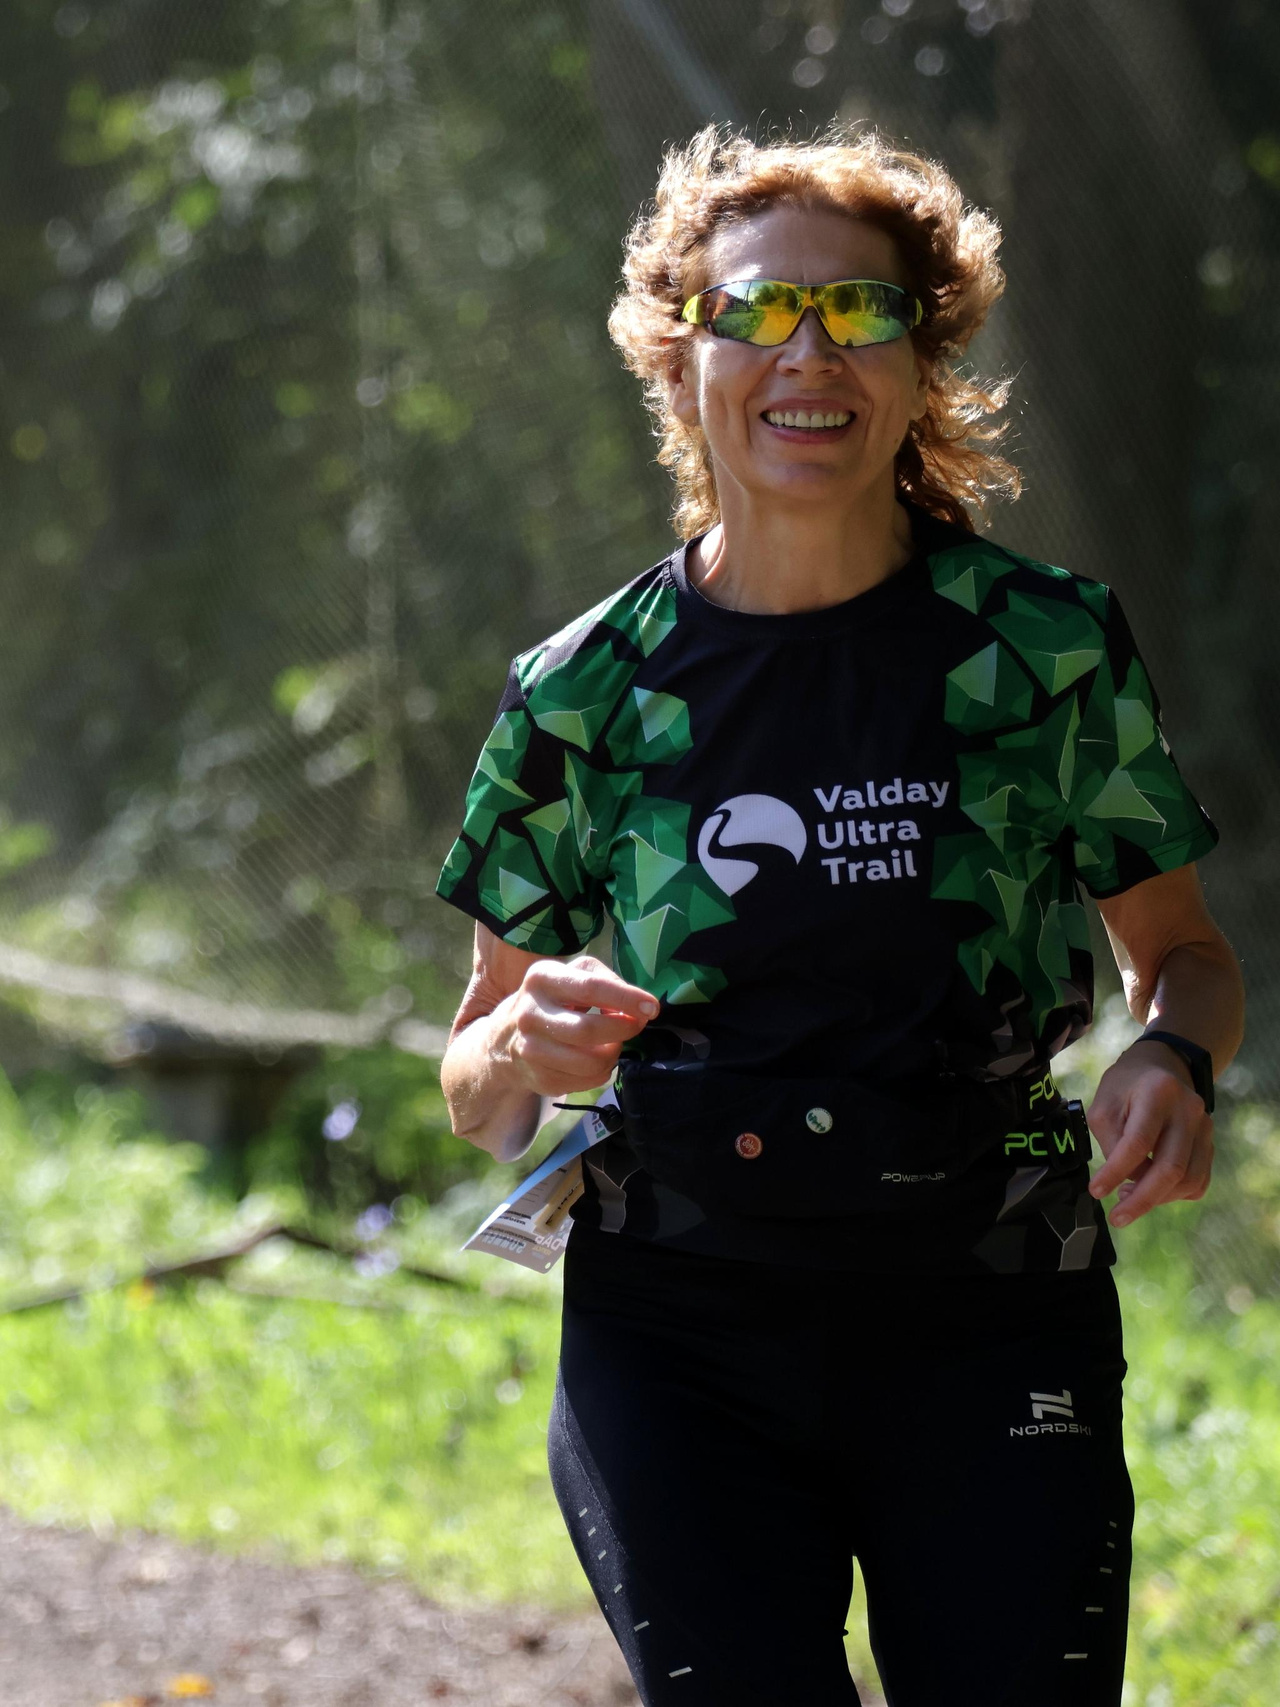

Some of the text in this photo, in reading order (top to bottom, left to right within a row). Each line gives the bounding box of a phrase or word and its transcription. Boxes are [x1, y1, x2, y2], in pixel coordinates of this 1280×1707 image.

[813, 777, 950, 813] Valday
[817, 818, 921, 850] Ultra
[821, 849, 918, 886] Trail
[1009, 1423, 1092, 1437] NORDSKI
